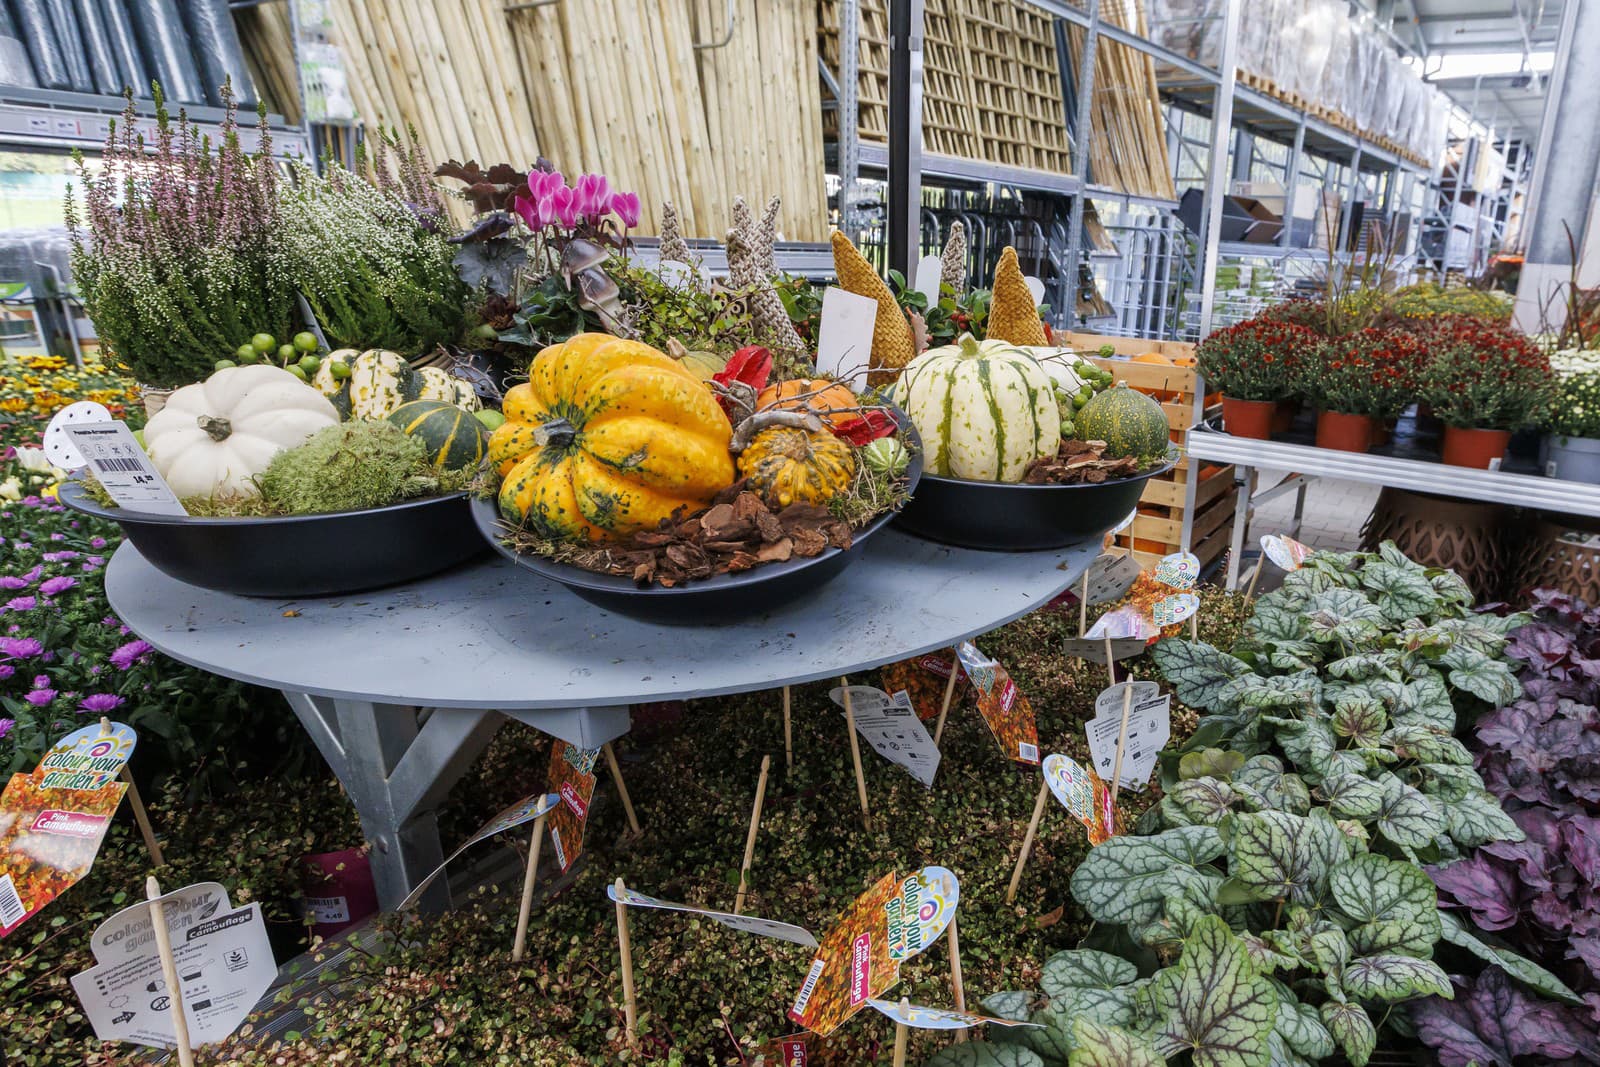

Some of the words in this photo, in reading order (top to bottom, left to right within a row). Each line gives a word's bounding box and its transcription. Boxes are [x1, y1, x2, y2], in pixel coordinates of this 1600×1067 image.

[43, 751, 90, 769] colour
[85, 756, 125, 776] your
[39, 769, 94, 789] garden
[36, 817, 98, 835] Camouflage
[50, 811, 69, 822] Pink
[903, 876, 922, 917] colour
[189, 912, 252, 939] Camouflage
[198, 920, 217, 931] Pink
[884, 897, 904, 948] garden
[905, 916, 923, 950] your
[861, 944, 871, 963] Pink
[852, 938, 865, 1002] Camouflage
